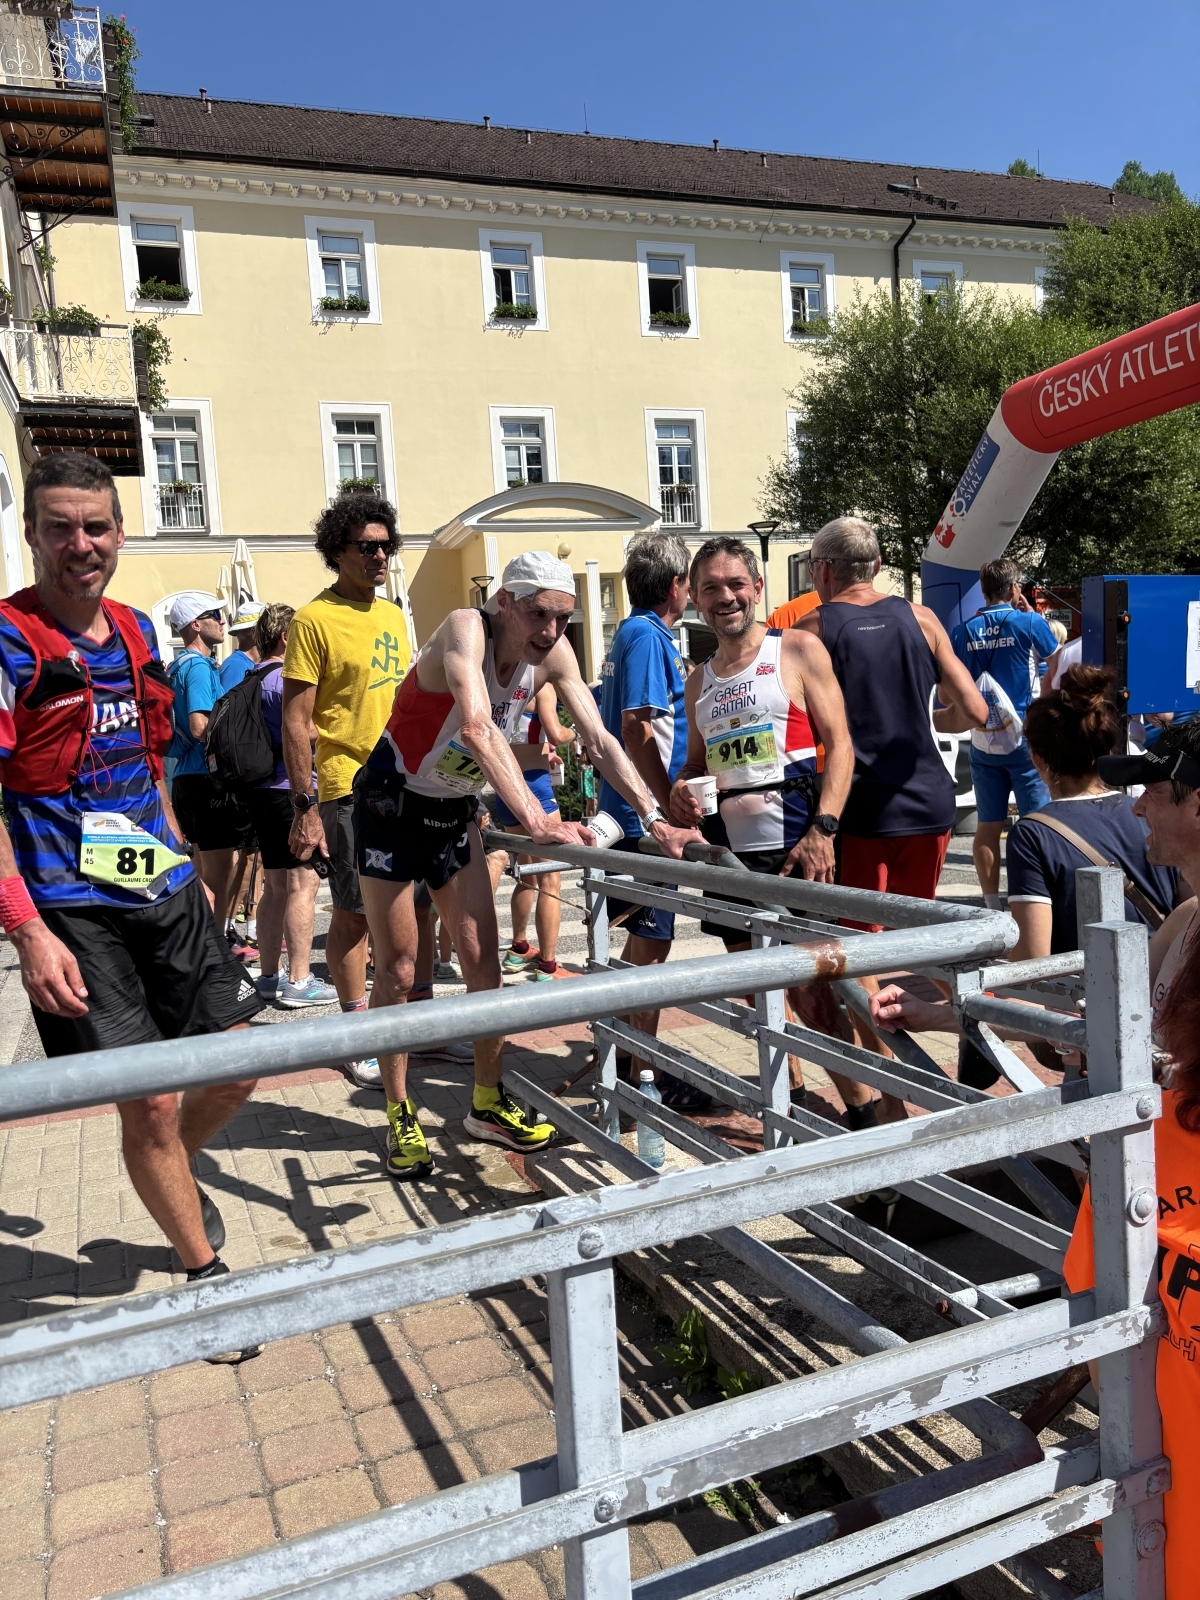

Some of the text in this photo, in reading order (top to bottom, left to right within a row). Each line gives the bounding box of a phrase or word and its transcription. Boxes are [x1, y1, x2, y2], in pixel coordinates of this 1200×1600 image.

[1039, 321, 1200, 417] ČESKÝ ATLET
[964, 472, 982, 501] SVAZ
[979, 625, 1000, 637] LOC
[966, 636, 1016, 652] MEMBER
[714, 680, 754, 703] GREAT
[711, 694, 756, 719] BRITAIN
[718, 736, 759, 763] 914
[423, 817, 458, 829] KIPRUN
[116, 847, 155, 876] 81
[639, 919, 657, 928] OLYMP
[236, 986, 257, 1002] adidas
[1158, 1185, 1200, 1221] AR
